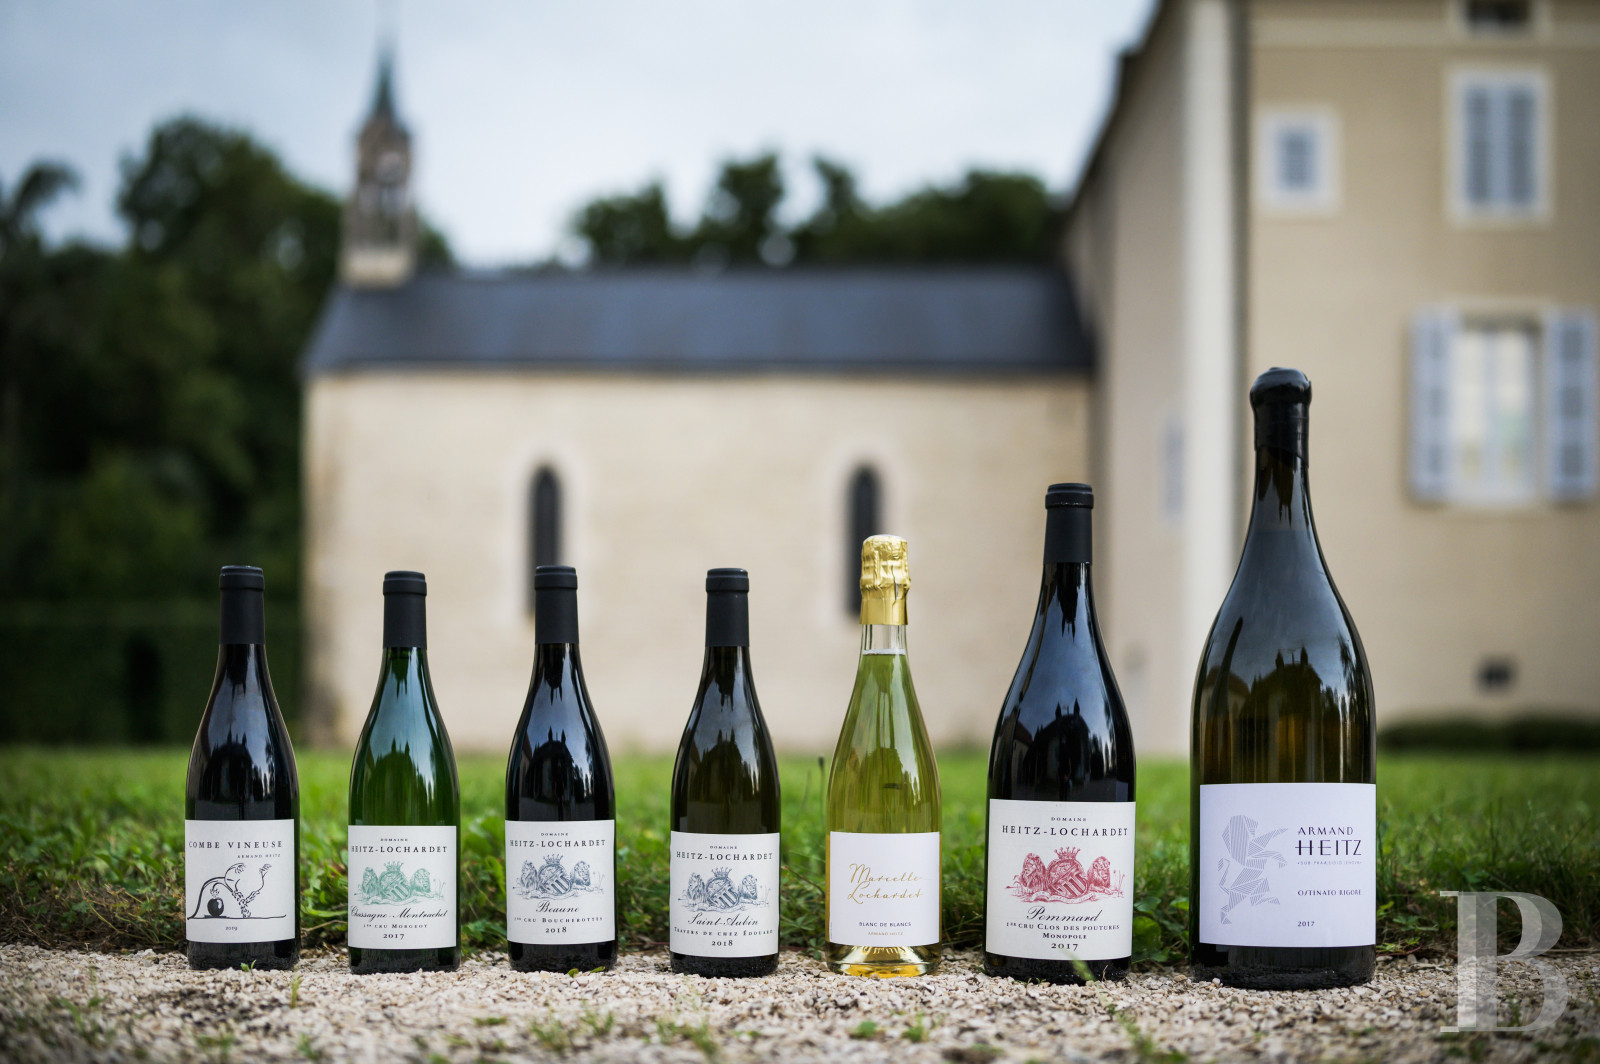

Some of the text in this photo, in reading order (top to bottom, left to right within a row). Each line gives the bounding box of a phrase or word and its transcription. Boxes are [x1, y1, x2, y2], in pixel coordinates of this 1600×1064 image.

[1002, 824, 1128, 837] HEITZ-LOCHARDET
[1297, 826, 1354, 836] ARMAND
[188, 840, 282, 849] COMBE VINEUSE
[509, 839, 606, 848] HEITZ-LOCHARDET
[1294, 839, 1363, 856] HEITZ
[676, 851, 773, 861] HEITZ-LOCHARDET
[849, 863, 923, 884] Marcelle
[847, 880, 925, 905] Lochardet
[535, 900, 580, 913] Beaune
[687, 912, 759, 926] Saint-Aubin
[1026, 905, 1103, 922] Pommard
[545, 926, 567, 934] 2018
[711, 939, 733, 947] 2018
[1050, 943, 1079, 952] 2017
